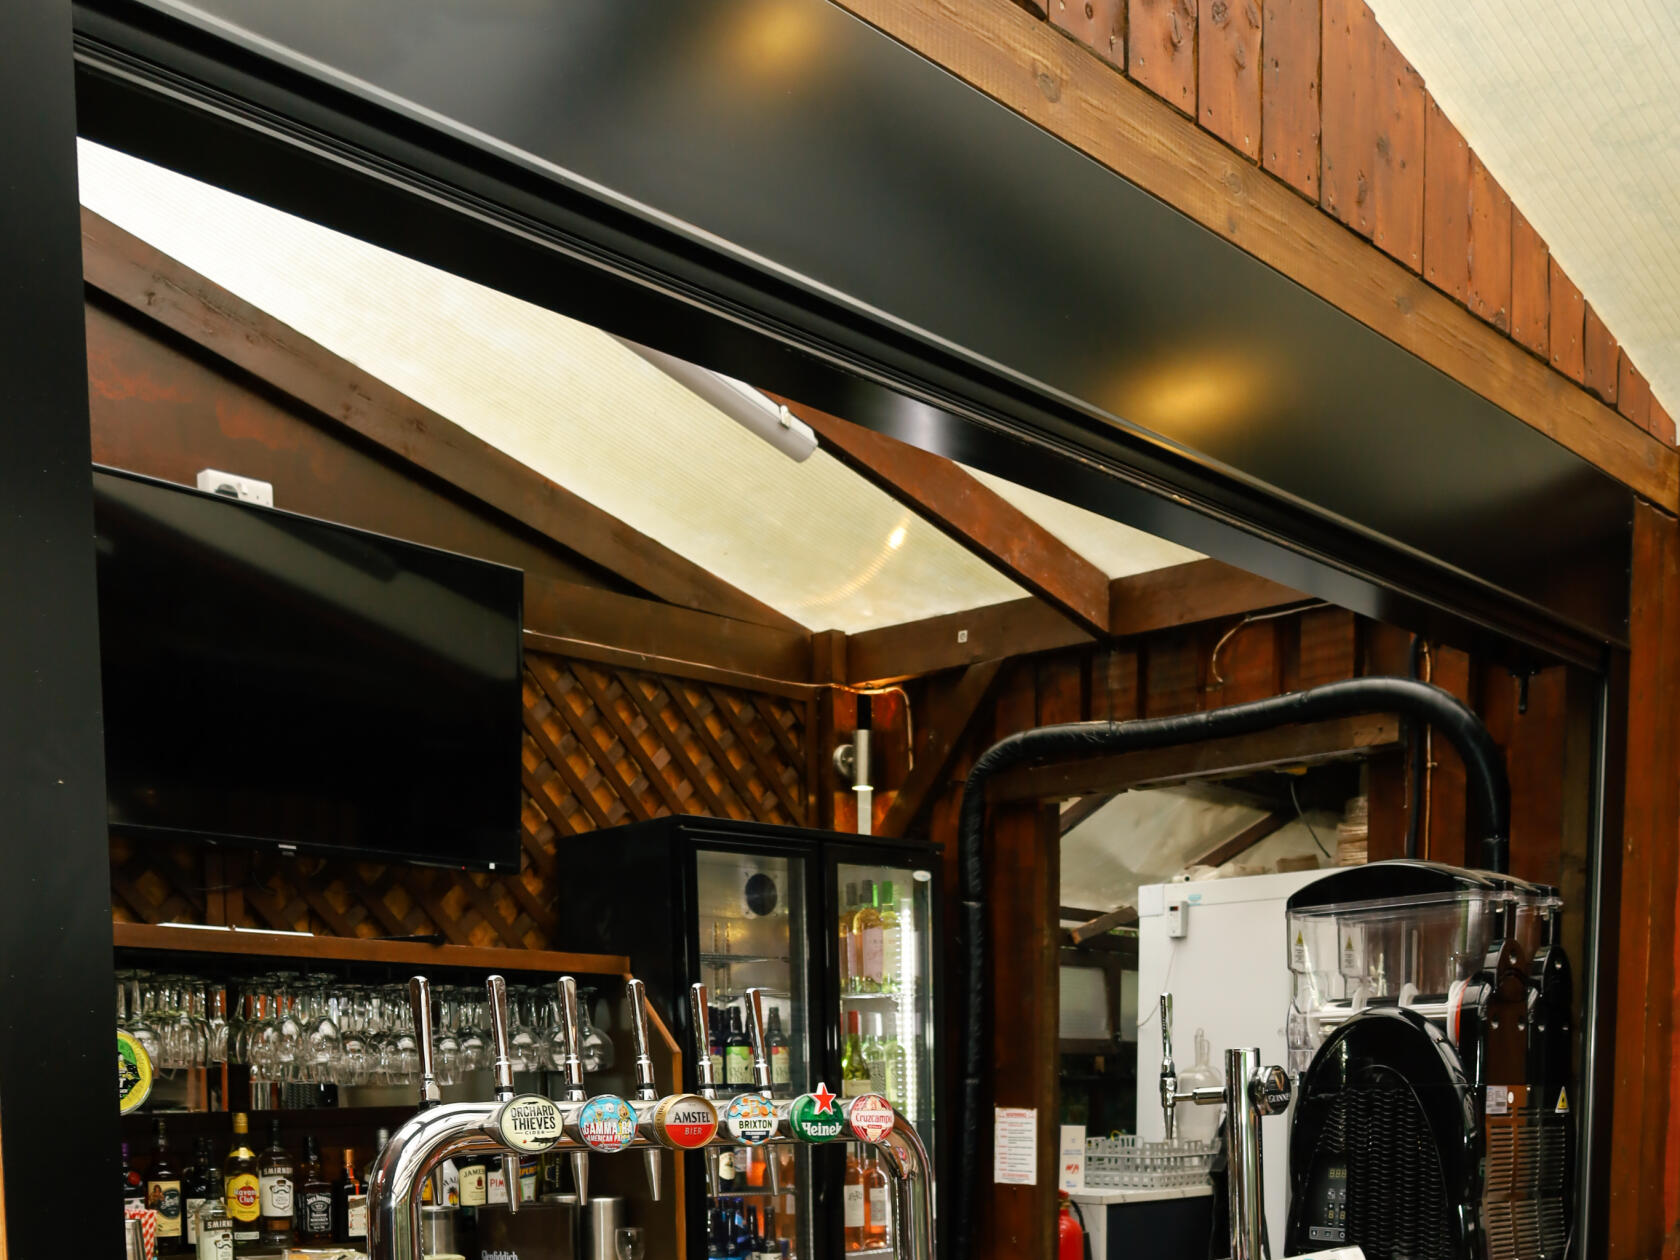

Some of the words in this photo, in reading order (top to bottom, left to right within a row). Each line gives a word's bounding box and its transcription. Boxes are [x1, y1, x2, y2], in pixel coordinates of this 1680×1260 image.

[511, 1105, 554, 1118] ORCHARD
[673, 1111, 711, 1123] AMSTEL
[512, 1117, 556, 1130] THIEVES
[583, 1120, 618, 1135] GAMMA
[739, 1119, 773, 1129] BRIXTON
[684, 1127, 703, 1136] BIER
[239, 1195, 255, 1203] Club
